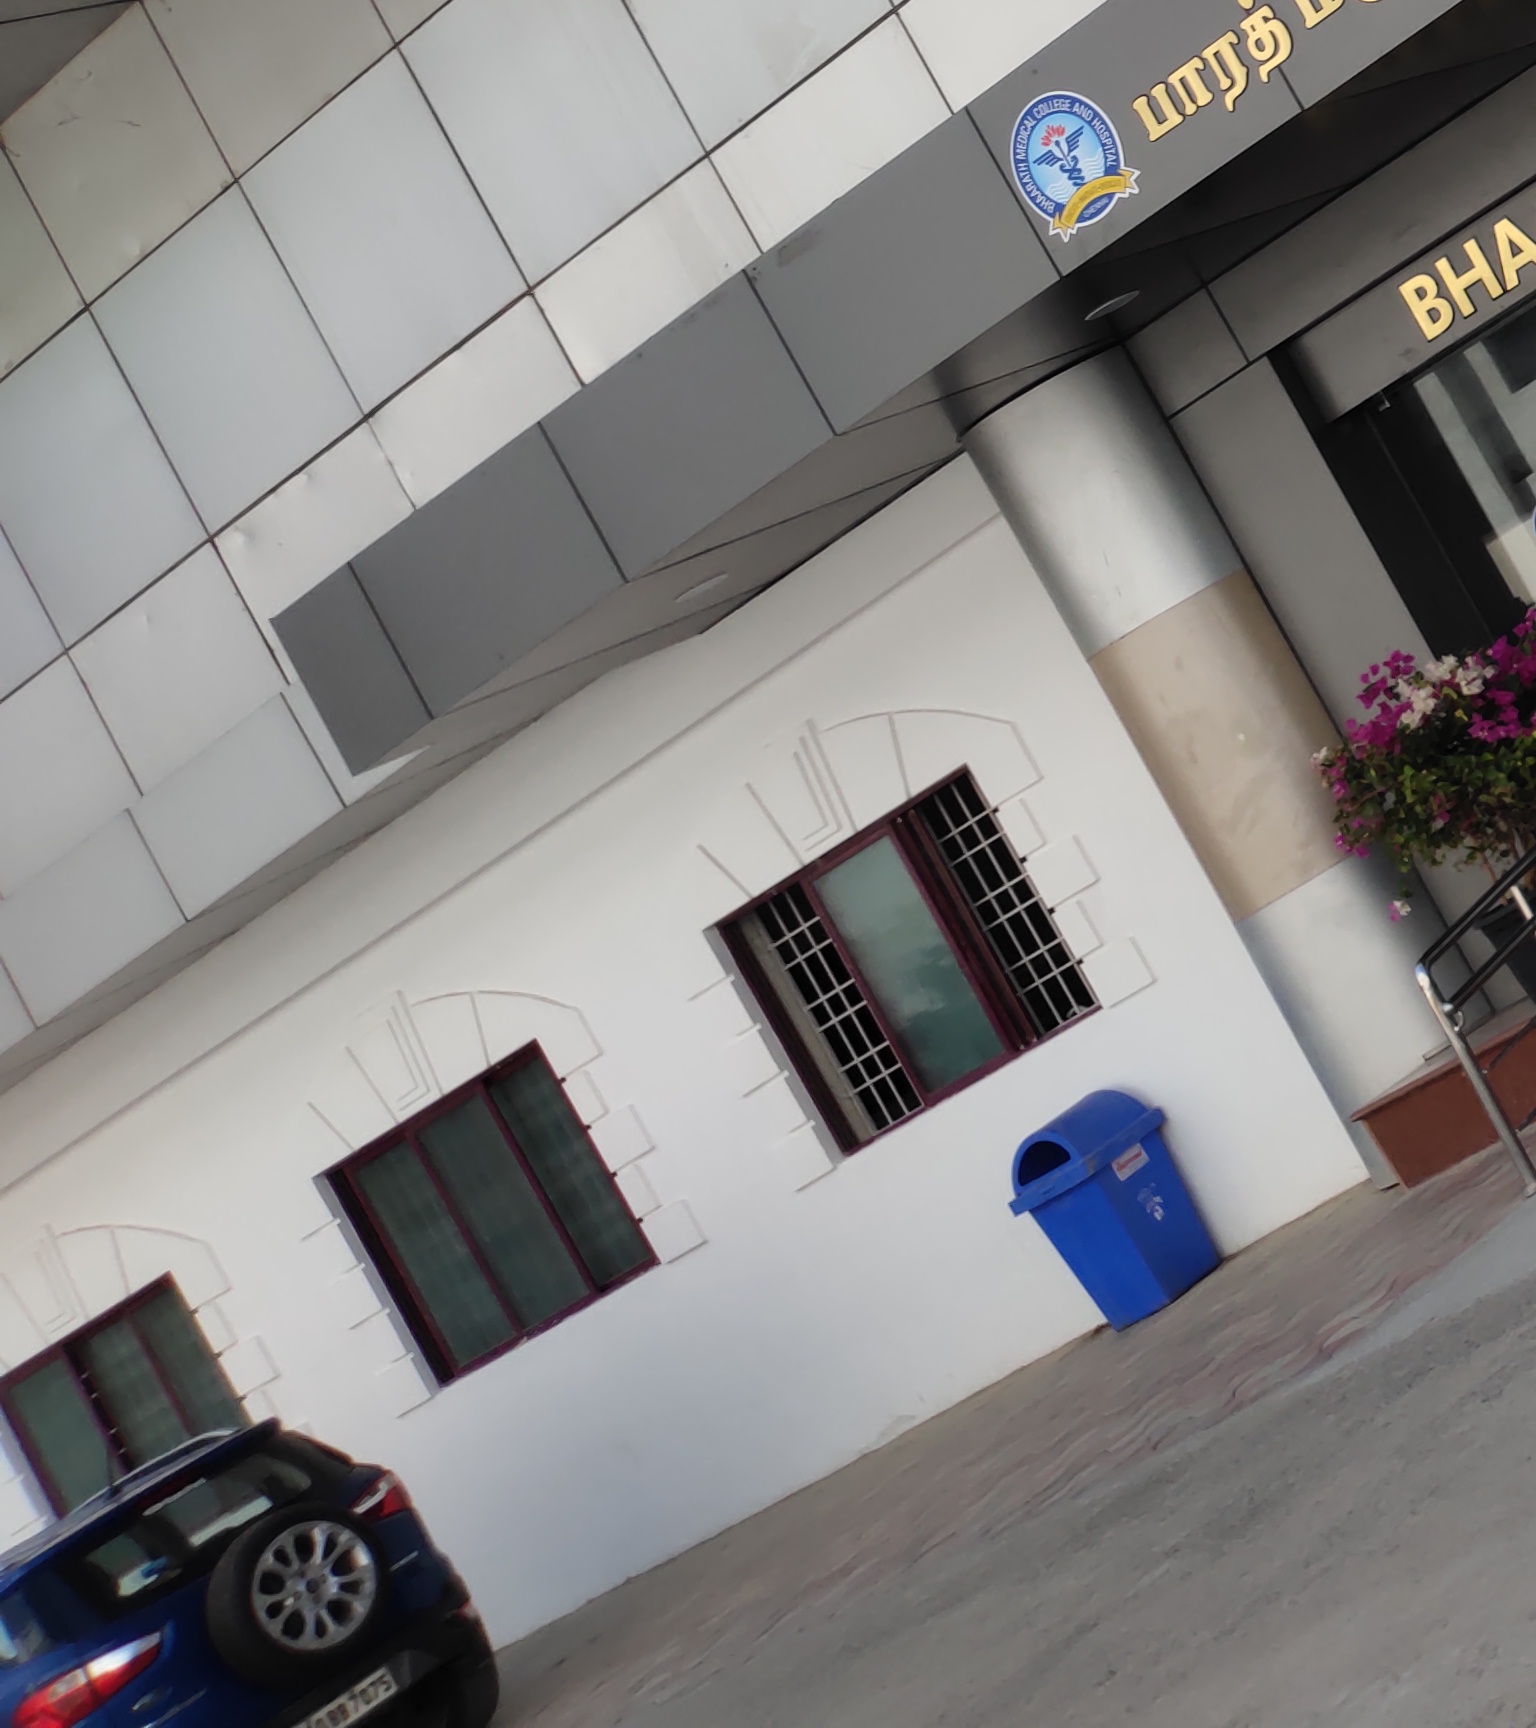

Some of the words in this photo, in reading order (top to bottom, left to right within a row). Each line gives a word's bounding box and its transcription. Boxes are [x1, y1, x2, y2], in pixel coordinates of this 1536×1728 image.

[1015, 115, 1038, 161] MEDICAL
[1032, 98, 1073, 120] COLLEGE
[1072, 102, 1094, 122] AND
[1092, 117, 1118, 167] HOSPITAL
